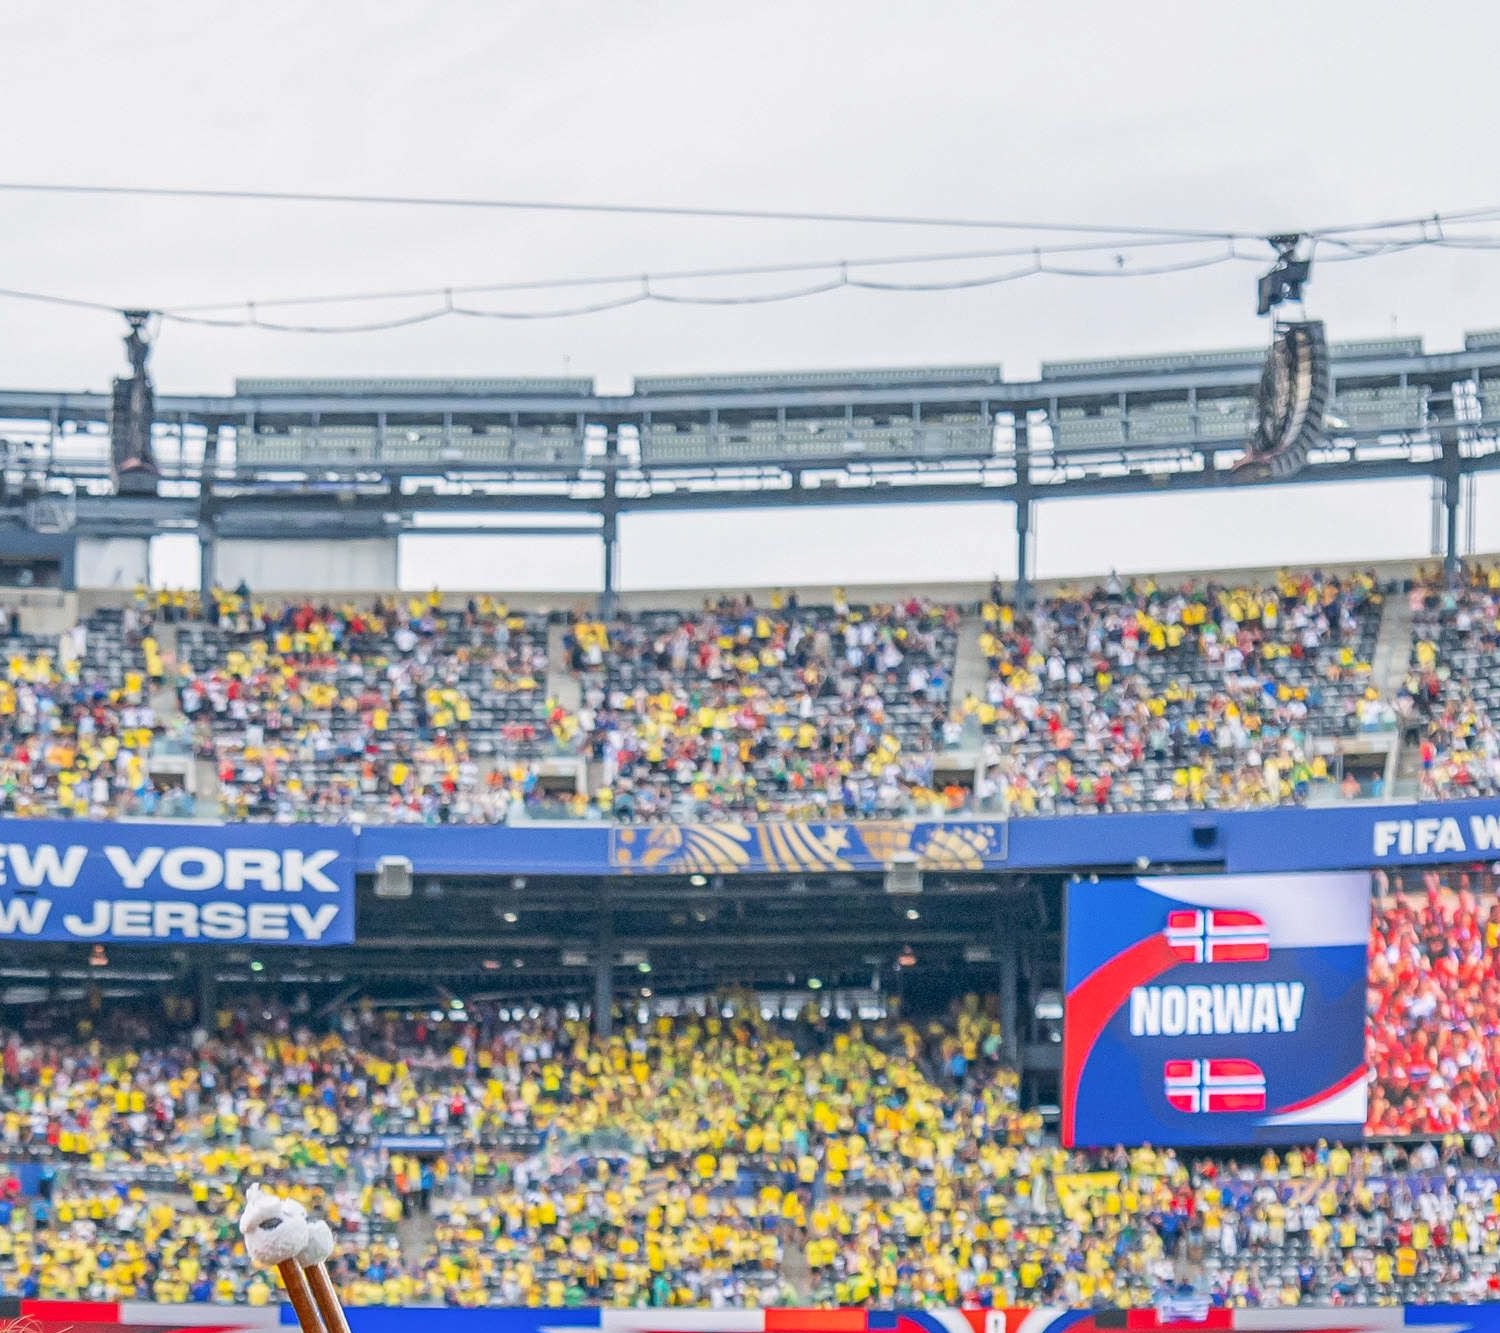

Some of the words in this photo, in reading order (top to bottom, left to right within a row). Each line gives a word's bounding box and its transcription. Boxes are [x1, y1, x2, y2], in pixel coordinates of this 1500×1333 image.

[1372, 818, 1467, 857] FIFA
[103, 845, 340, 893] YORK
[63, 899, 340, 941] JERSEY
[1130, 981, 1305, 1036] NORWAY
